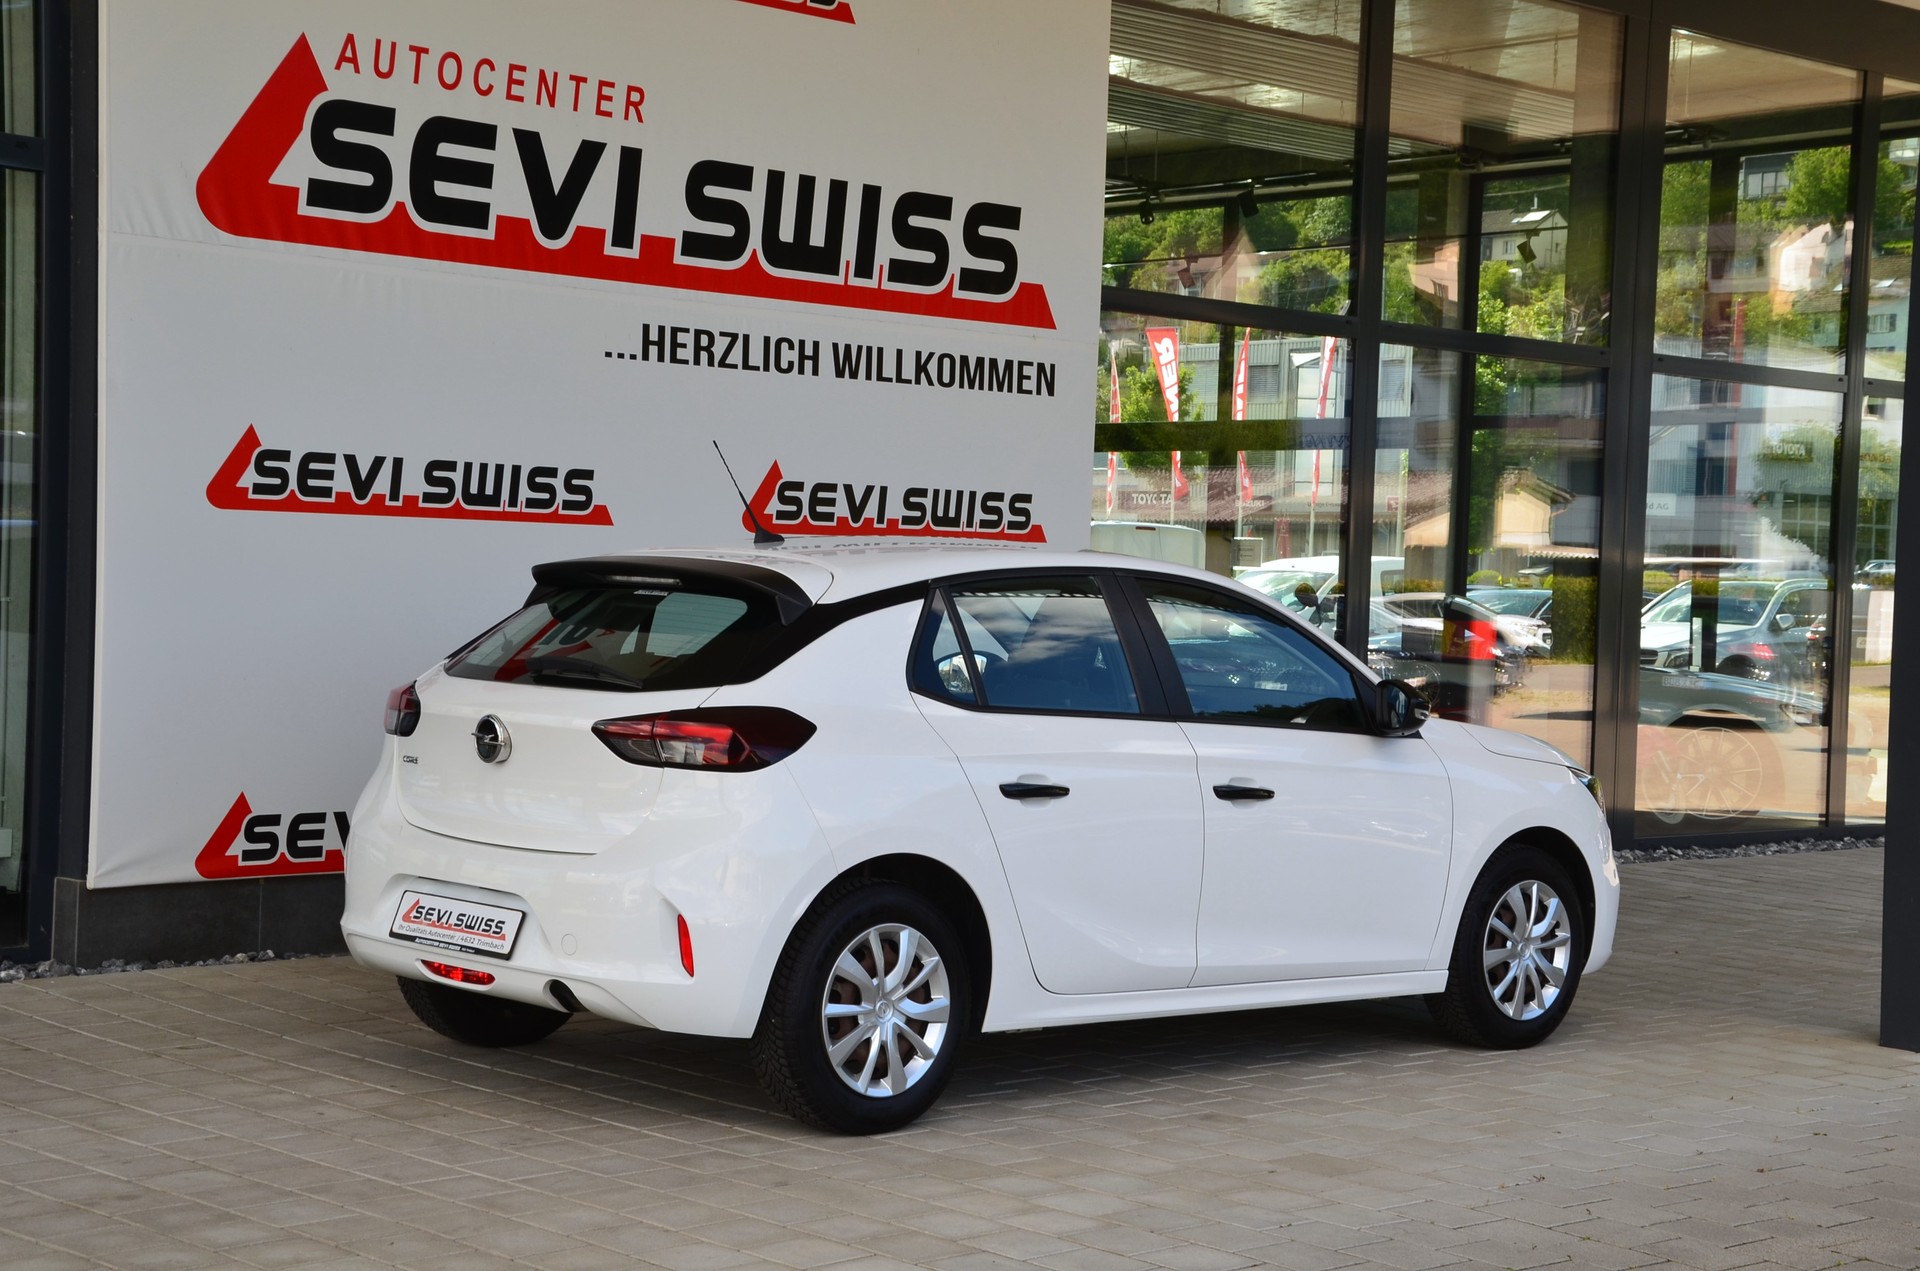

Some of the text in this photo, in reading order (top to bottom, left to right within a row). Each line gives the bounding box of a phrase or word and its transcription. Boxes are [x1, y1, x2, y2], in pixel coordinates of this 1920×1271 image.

[334, 33, 646, 124] AUTOCENTER
[305, 99, 1022, 296] SEVI SWISS
[831, 342, 1056, 398] WILLKOMMEN
[250, 449, 595, 513] SEVI SWISS
[775, 480, 1033, 531] SEVI SWISS
[412, 905, 506, 935] SEVI SWISS
[428, 930, 456, 941] Autocenter
[460, 936, 475, 945] 4632
[477, 939, 505, 950] Trimbach
